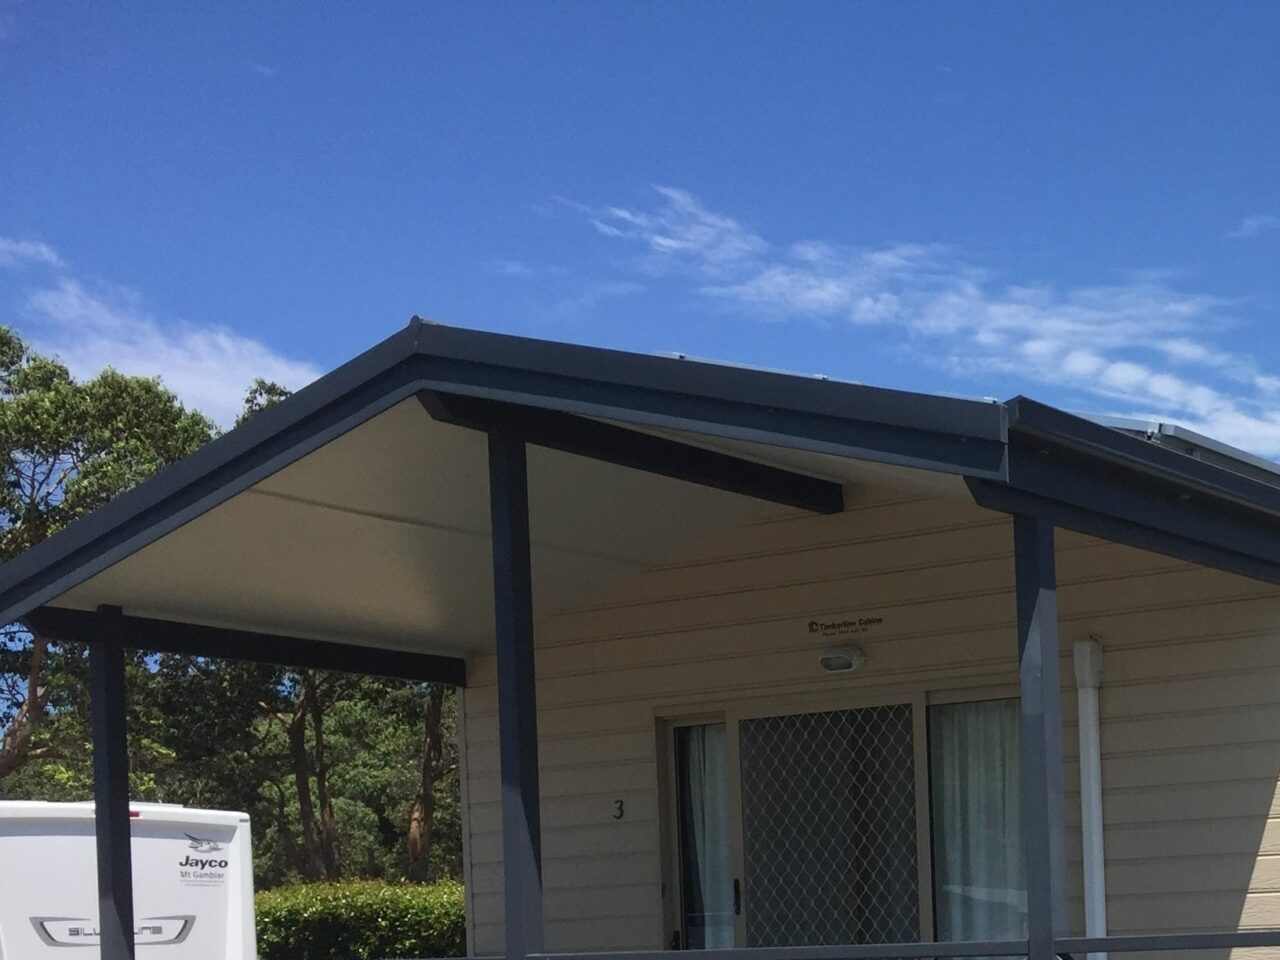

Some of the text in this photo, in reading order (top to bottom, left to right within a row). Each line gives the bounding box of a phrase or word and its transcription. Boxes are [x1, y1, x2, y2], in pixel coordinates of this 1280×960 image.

[613, 799, 625, 820] 3
[179, 855, 229, 870] Jayco
[180, 870, 225, 879] Mt Gambier
